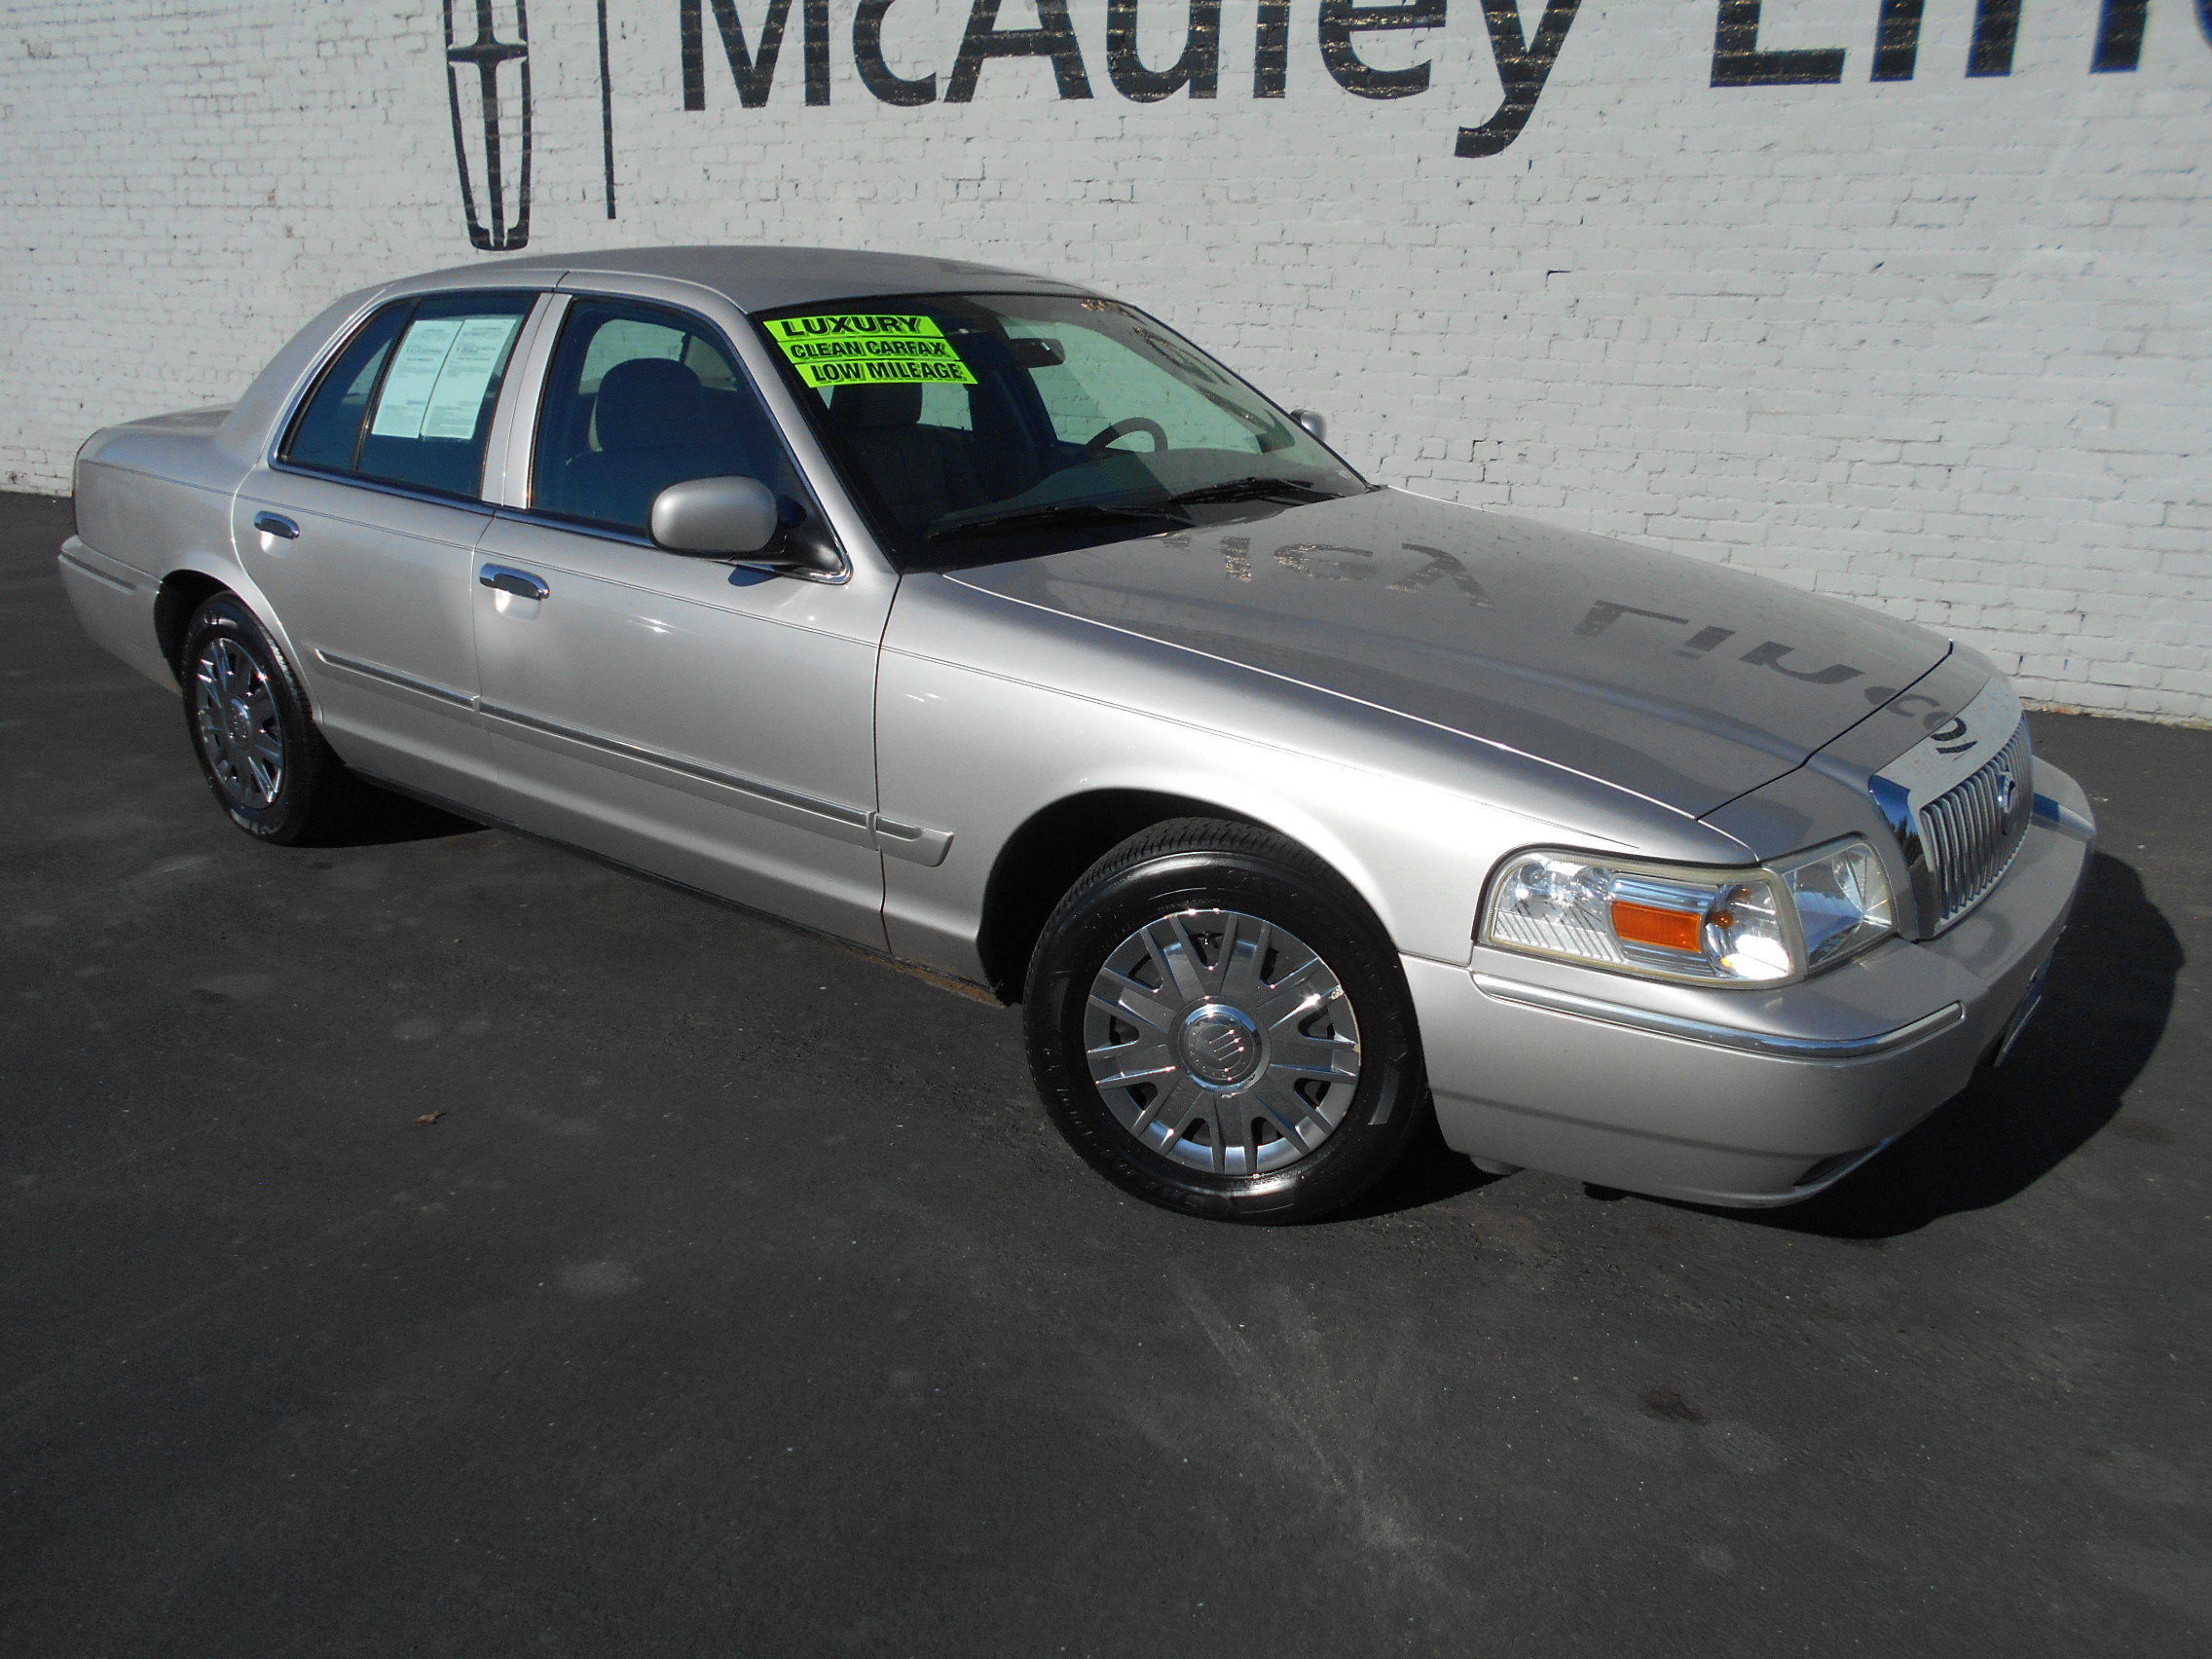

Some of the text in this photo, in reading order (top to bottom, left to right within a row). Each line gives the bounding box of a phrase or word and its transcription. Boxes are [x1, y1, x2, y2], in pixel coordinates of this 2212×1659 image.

[780, 315, 921, 337] LUXURY
[790, 340, 948, 359] CLEAN CARFAX
[810, 361, 966, 383] LOW MILEAGE
